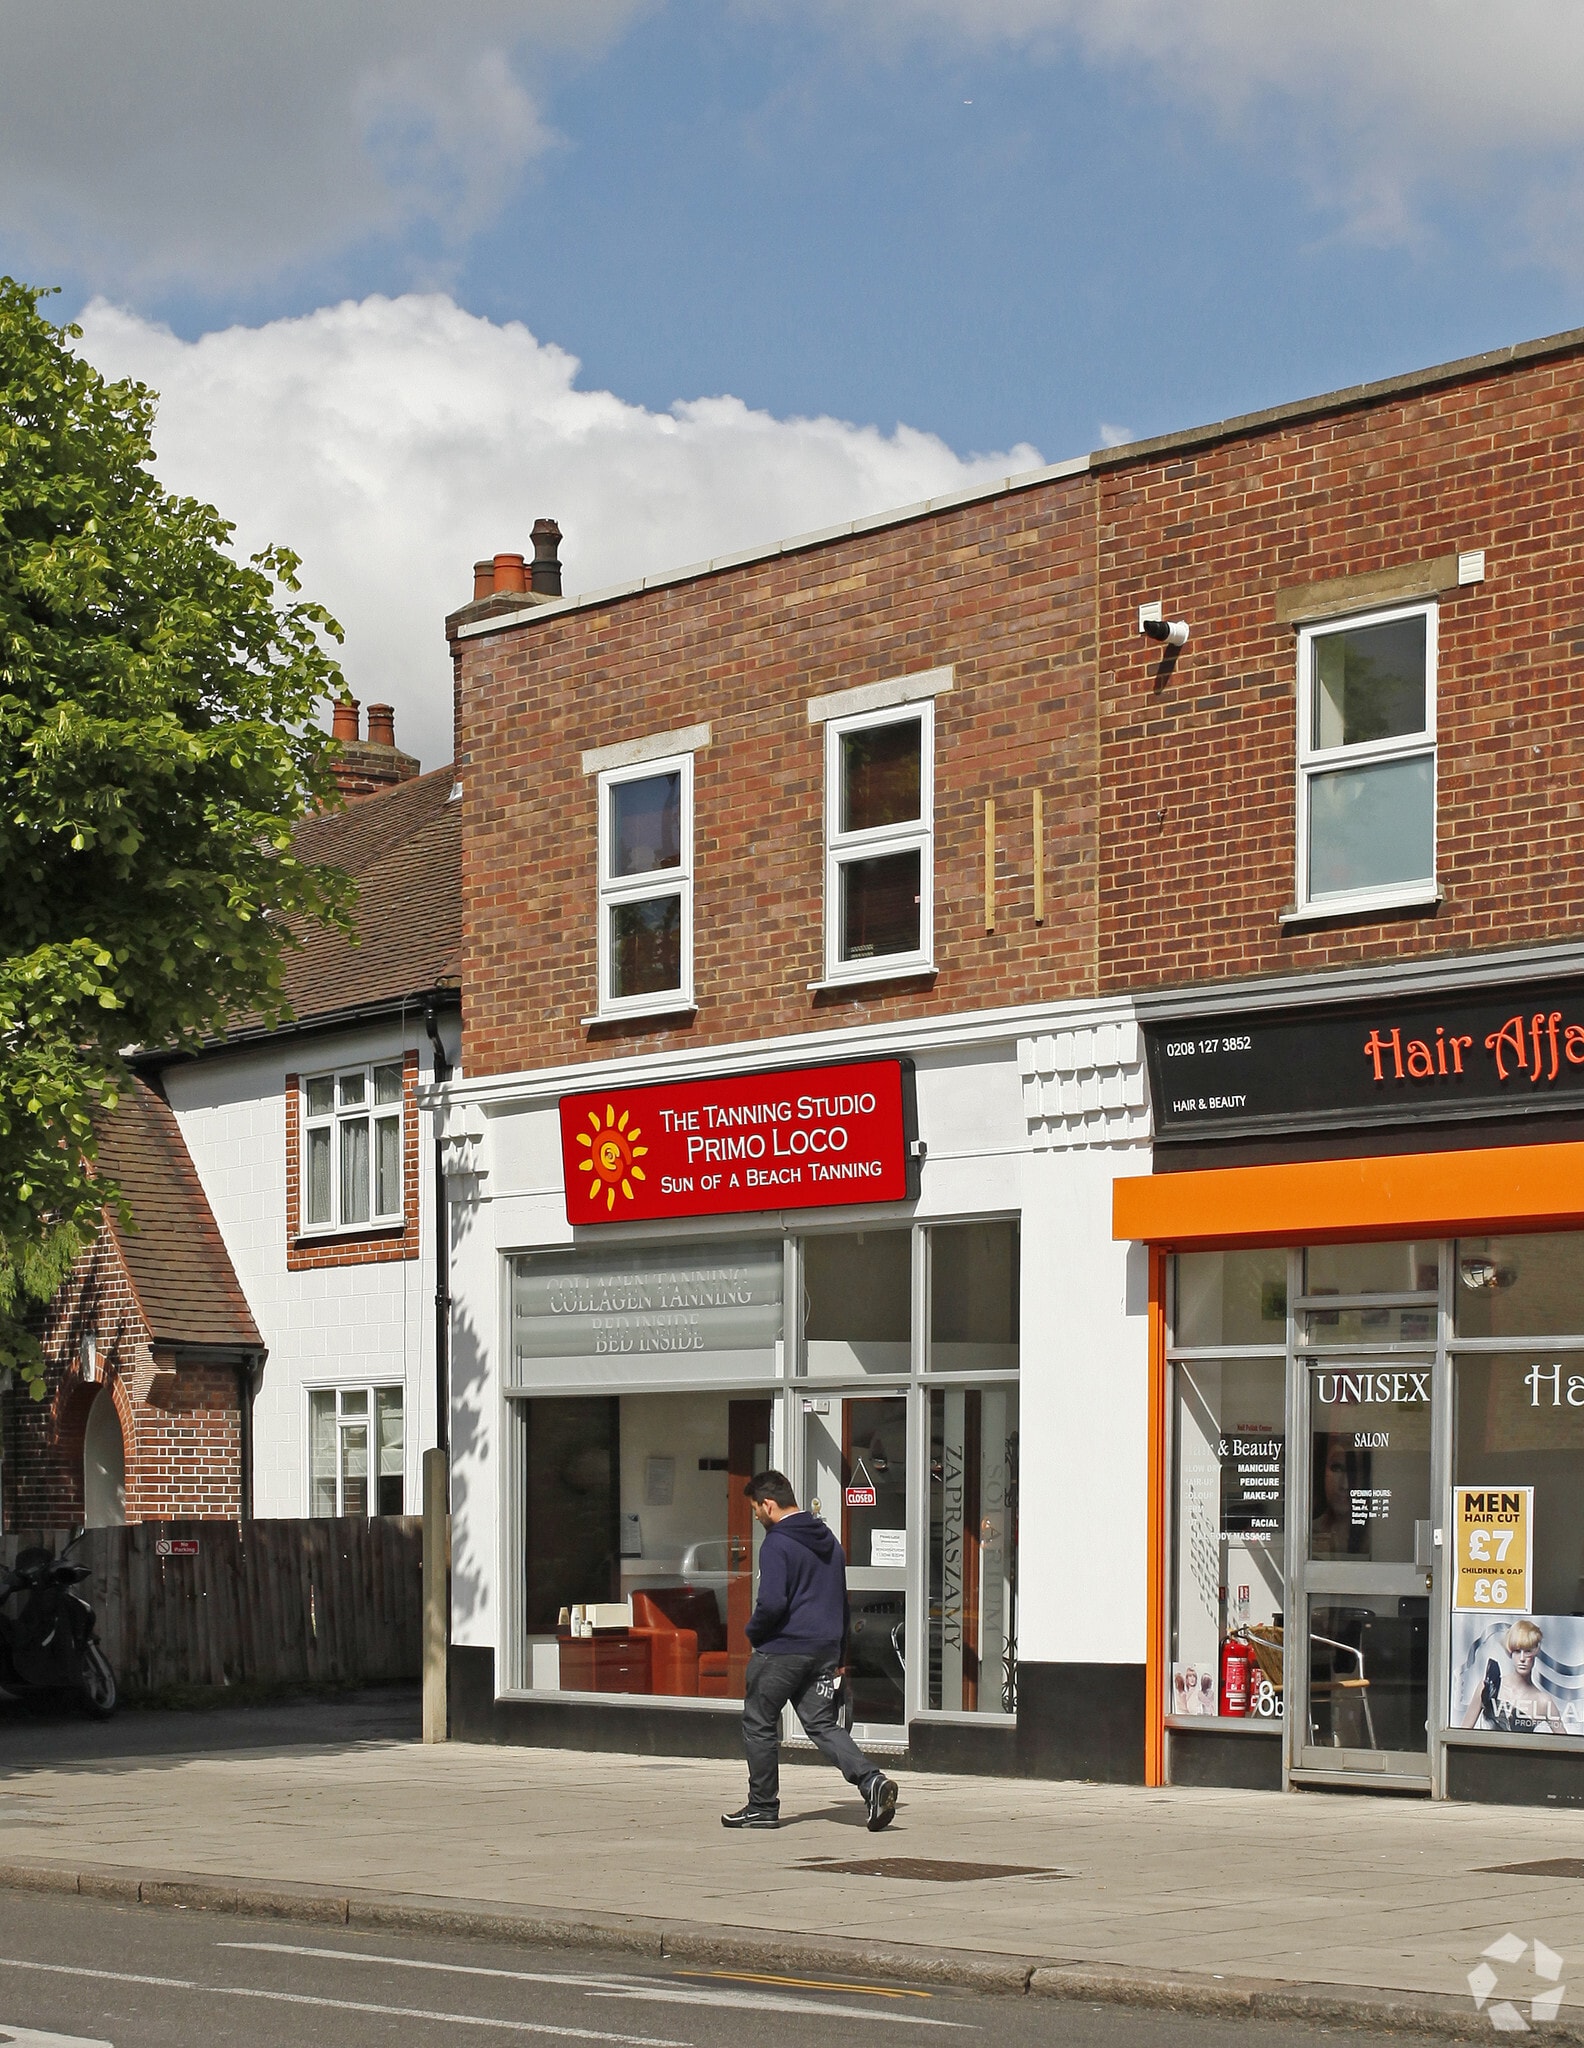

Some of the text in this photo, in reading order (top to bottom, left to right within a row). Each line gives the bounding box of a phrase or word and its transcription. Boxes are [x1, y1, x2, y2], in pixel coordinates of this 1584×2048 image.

[1166, 1036, 1252, 1057] 0208 127 3852
[1363, 1011, 1584, 1083] Hair Affa
[659, 1092, 877, 1133] THE TANNING STUDIO
[1172, 1095, 1247, 1112] HAIR & BEAUTY
[686, 1126, 849, 1164] PRIMO LOCO
[660, 1160, 883, 1194] SUN OF A BEACH TANNING
[547, 1268, 753, 1313] COLLAGEN TANNING
[592, 1313, 705, 1353] BED INSIDE
[1316, 1373, 1431, 1403] UNISEX
[1218, 1439, 1229, 1456] &
[1232, 1439, 1282, 1461] Beauty
[1354, 1432, 1390, 1448] SALON
[1237, 1464, 1280, 1473] MANICURE
[1240, 1478, 1280, 1486] PEDICURE
[848, 1494, 873, 1503] CLOSED
[1243, 1491, 1279, 1500] MAKE-UP
[1465, 1494, 1520, 1512] MEN
[1251, 1519, 1279, 1528] FACIAL
[1464, 1514, 1520, 1523] HAIR CUT
[944, 1445, 963, 1651] ZAPRASZAMY
[1233, 1532, 1271, 1541] MASSAGE
[1469, 1530, 1514, 1562] £7
[1474, 1579, 1508, 1604] £6
[1258, 1680, 1284, 1716] 8b
[1491, 1698, 1579, 1722] WELLA
